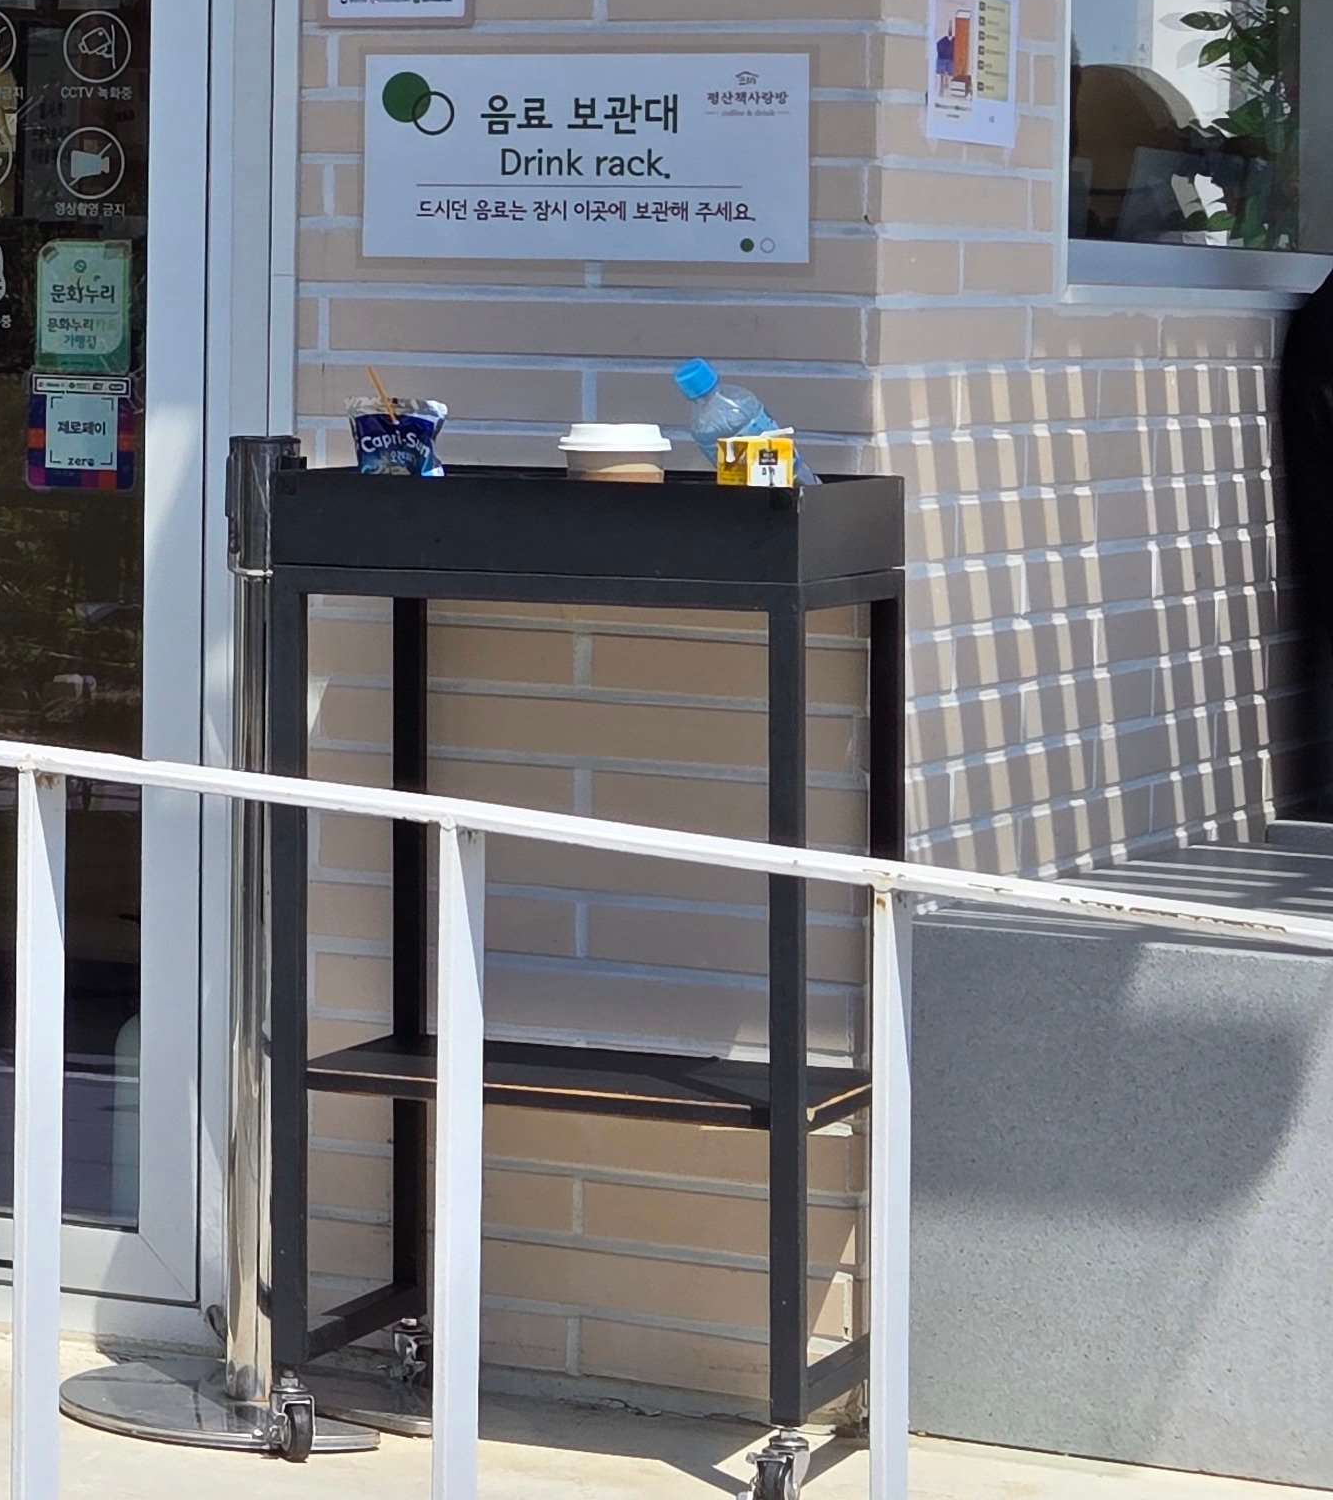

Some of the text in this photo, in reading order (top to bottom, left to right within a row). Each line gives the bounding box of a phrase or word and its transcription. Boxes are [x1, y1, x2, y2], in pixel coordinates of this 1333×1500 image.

[60, 86, 94, 100] CCTV
[480, 94, 679, 135] 음료 보관대
[500, 148, 671, 180] Drink rack.
[102, 203, 126, 216] 금지
[416, 198, 756, 223] 드시던 음료는 잠시 이곳에 보관해 주세요.
[50, 280, 116, 305] 문화누리
[58, 420, 106, 436] 제로페이
[361, 430, 430, 458] Capri-Sun
